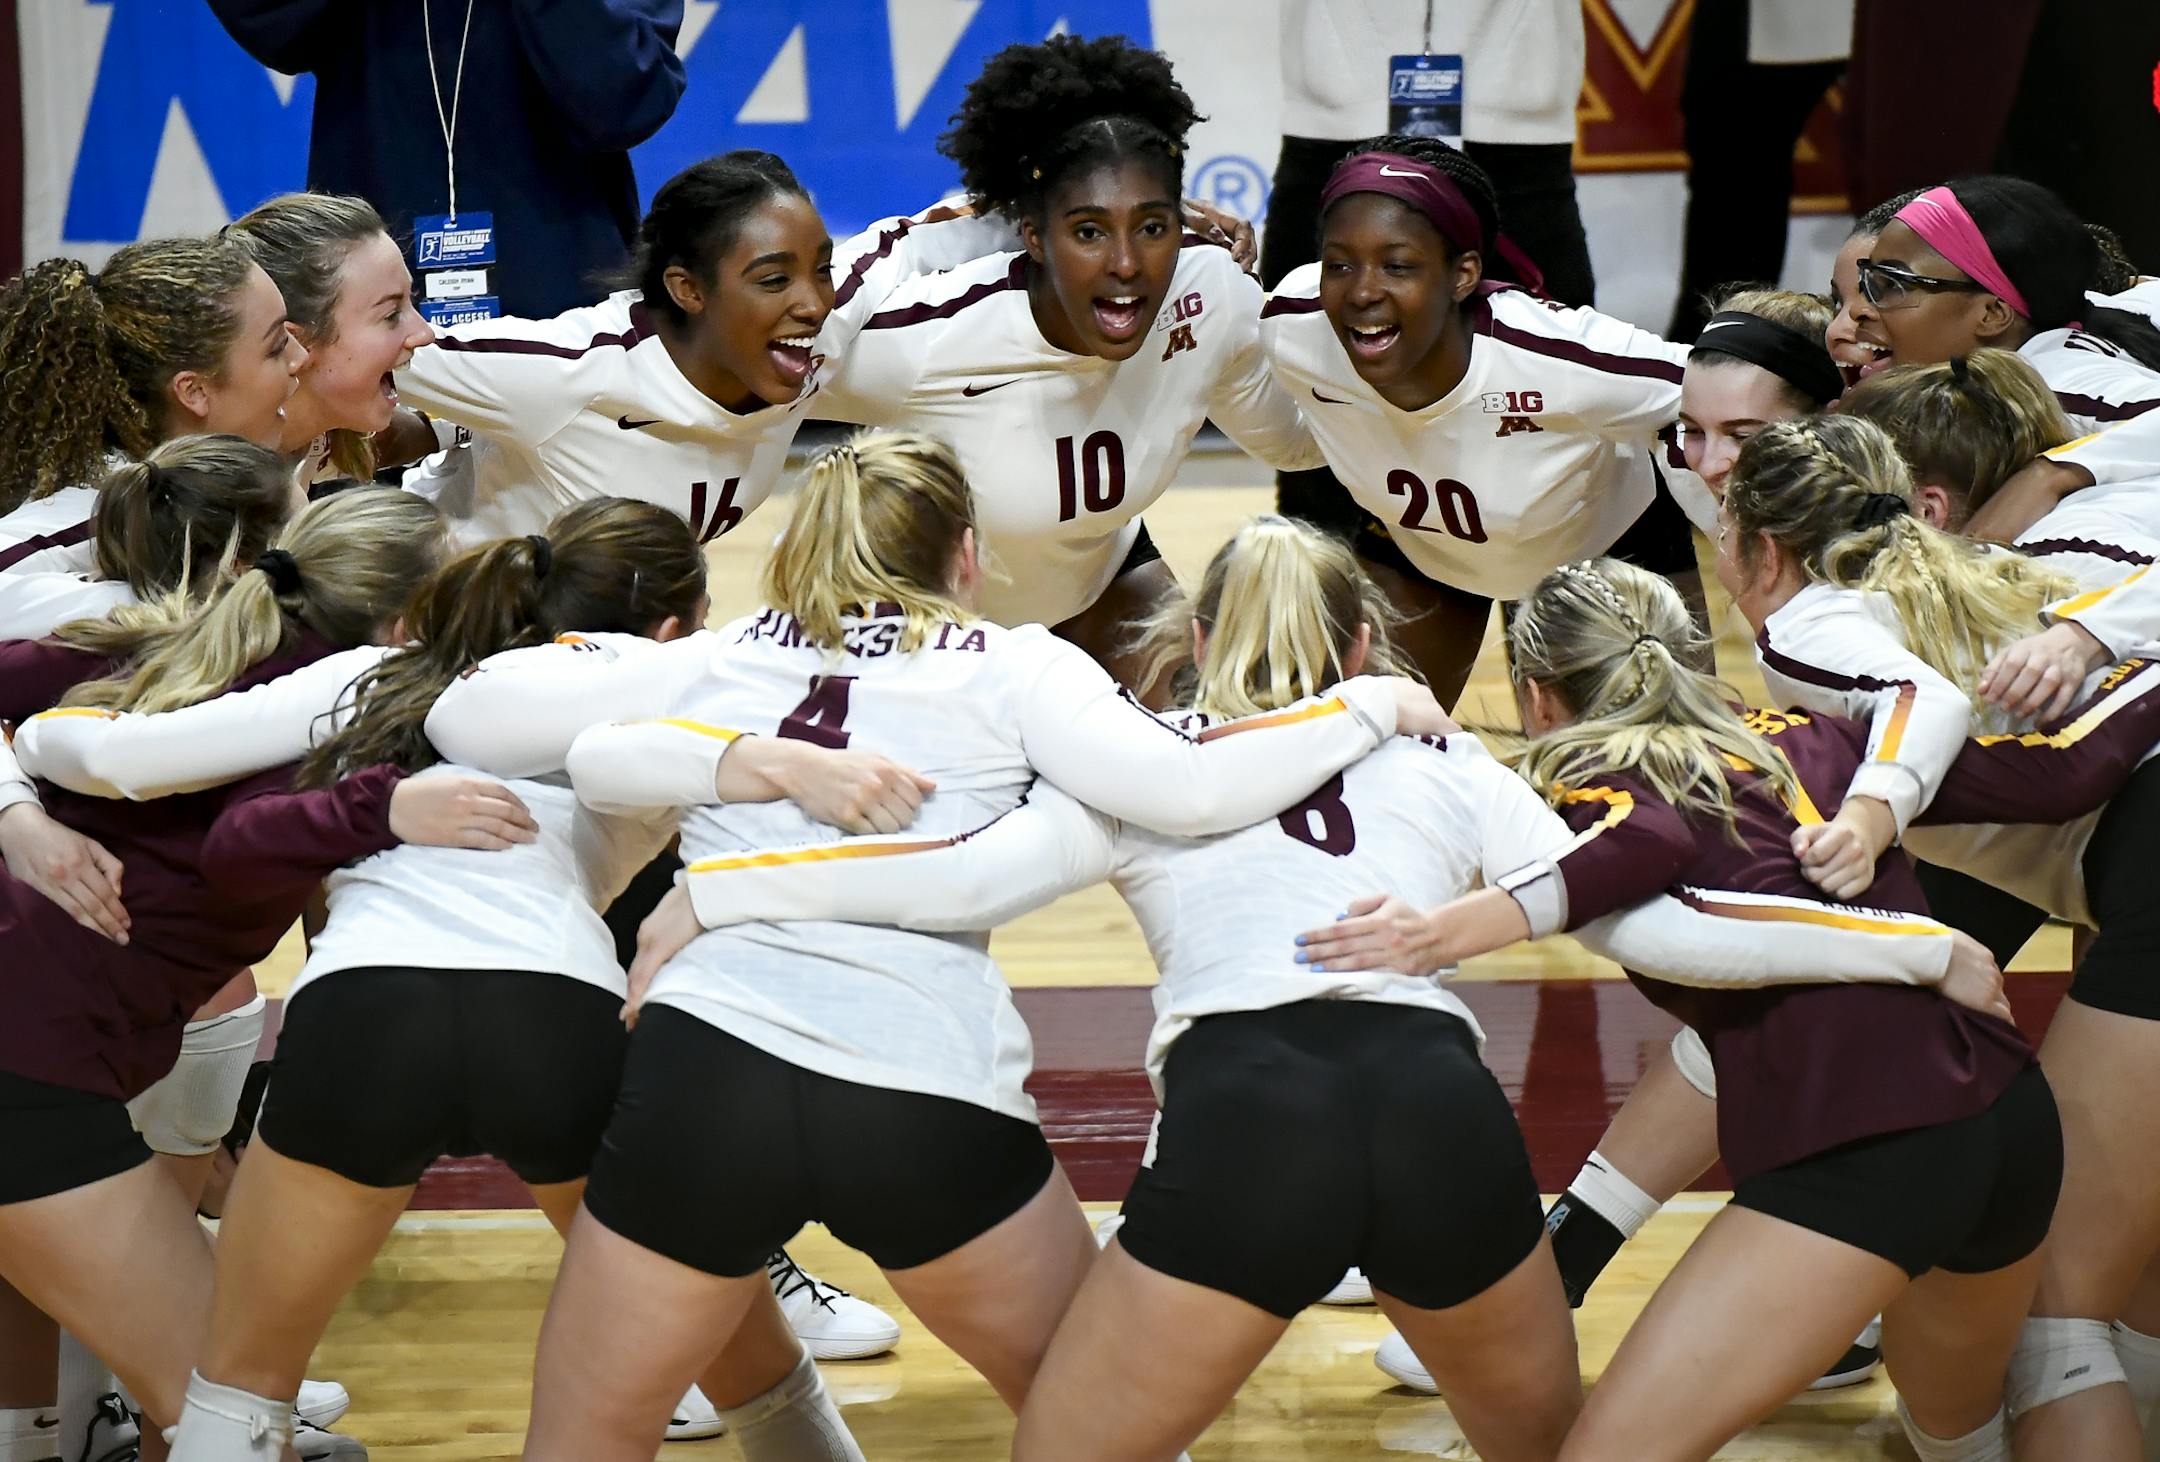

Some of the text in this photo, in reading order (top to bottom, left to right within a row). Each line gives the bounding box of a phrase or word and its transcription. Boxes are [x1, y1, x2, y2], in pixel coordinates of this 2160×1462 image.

[430, 311, 491, 325] ALL-ACCESS
[687, 476, 744, 545] 16
[1055, 430, 1125, 522] 10
[1386, 469, 1488, 544] 20
[776, 674, 859, 749] 4
